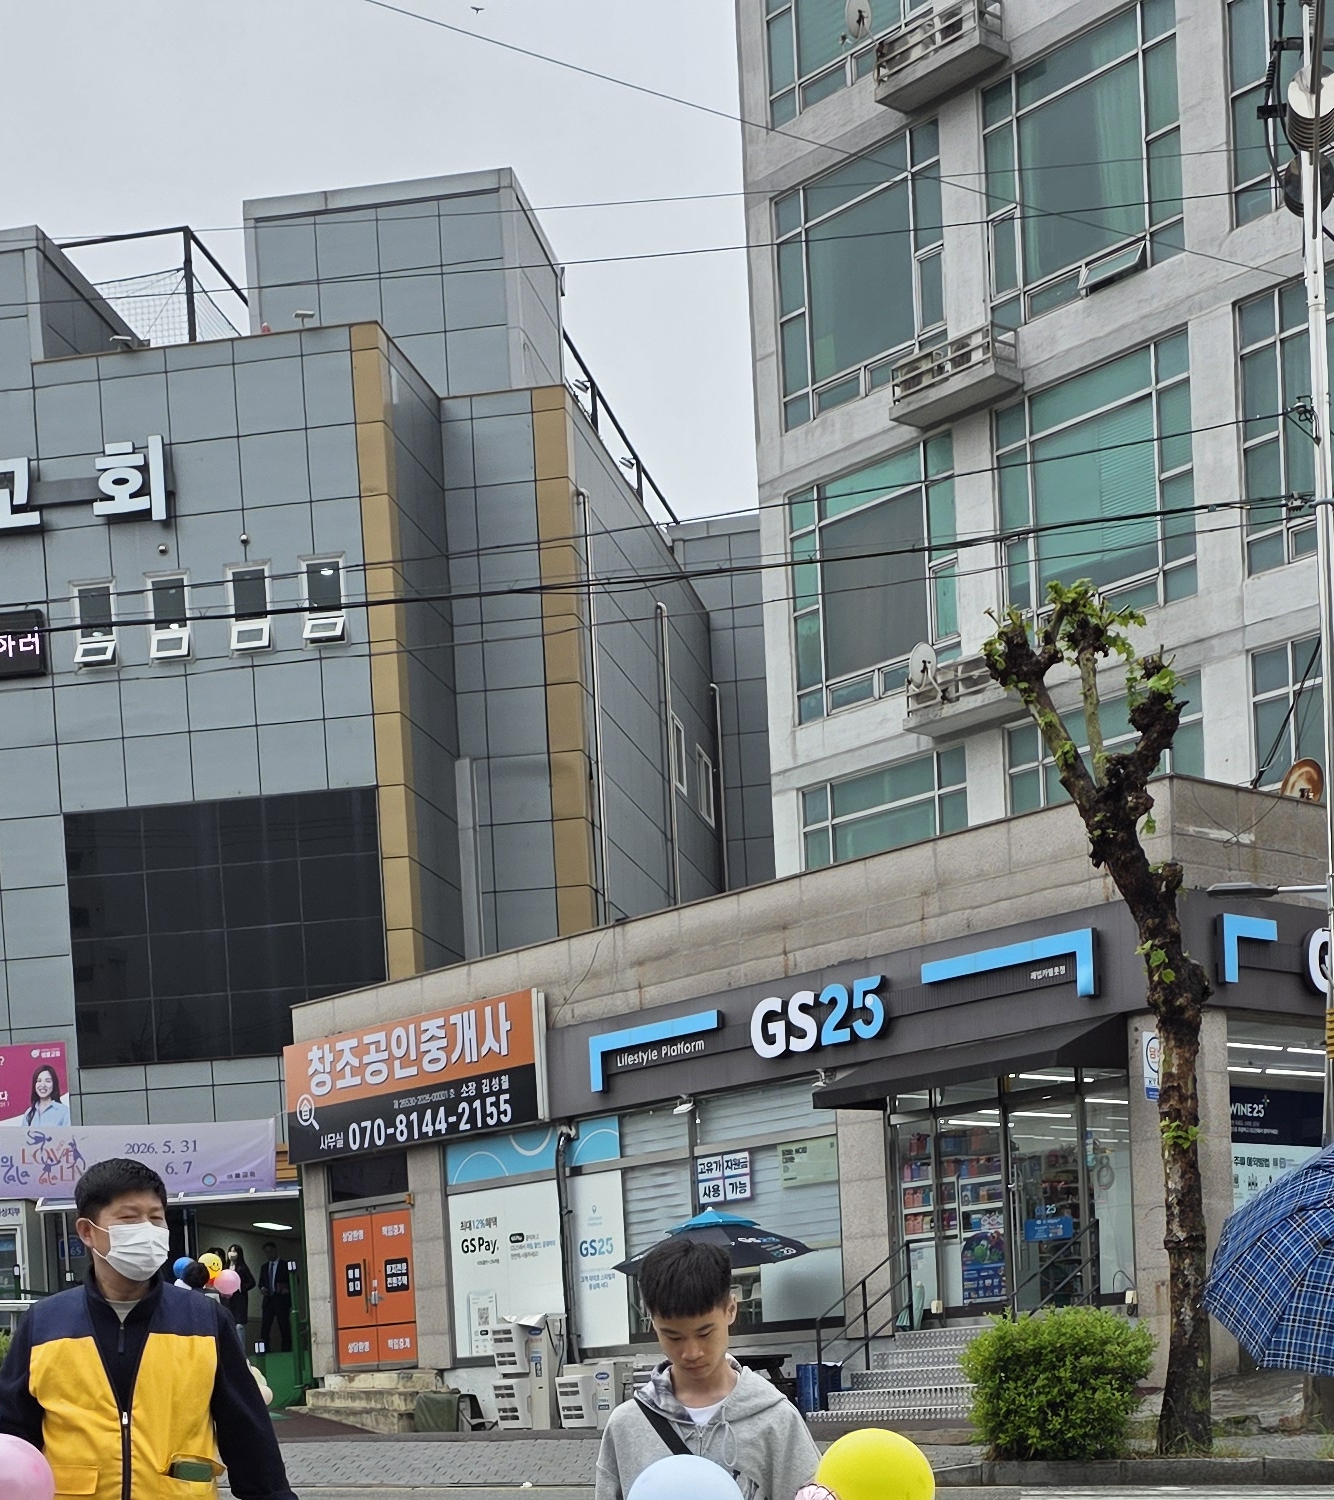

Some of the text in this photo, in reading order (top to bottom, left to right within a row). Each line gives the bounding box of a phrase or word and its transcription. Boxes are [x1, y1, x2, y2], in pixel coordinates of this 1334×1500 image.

[750, 974, 886, 1059] GS25
[307, 1001, 512, 1096] 창조공인중개사
[617, 1038, 705, 1068] Lifestyle Platform
[460, 1081, 477, 1098] 소장
[1230, 1102, 1265, 1118] WINE25
[319, 1093, 512, 1151] 사무실 070-8144-2155
[180, 1139, 198, 1153] 31
[183, 1161, 192, 1174] 7
[698, 1156, 748, 1175] 고유가 지원금
[702, 1180, 747, 1199] 사용 가능
[461, 1238, 476, 1254] GS
[579, 1237, 613, 1258] GS25
